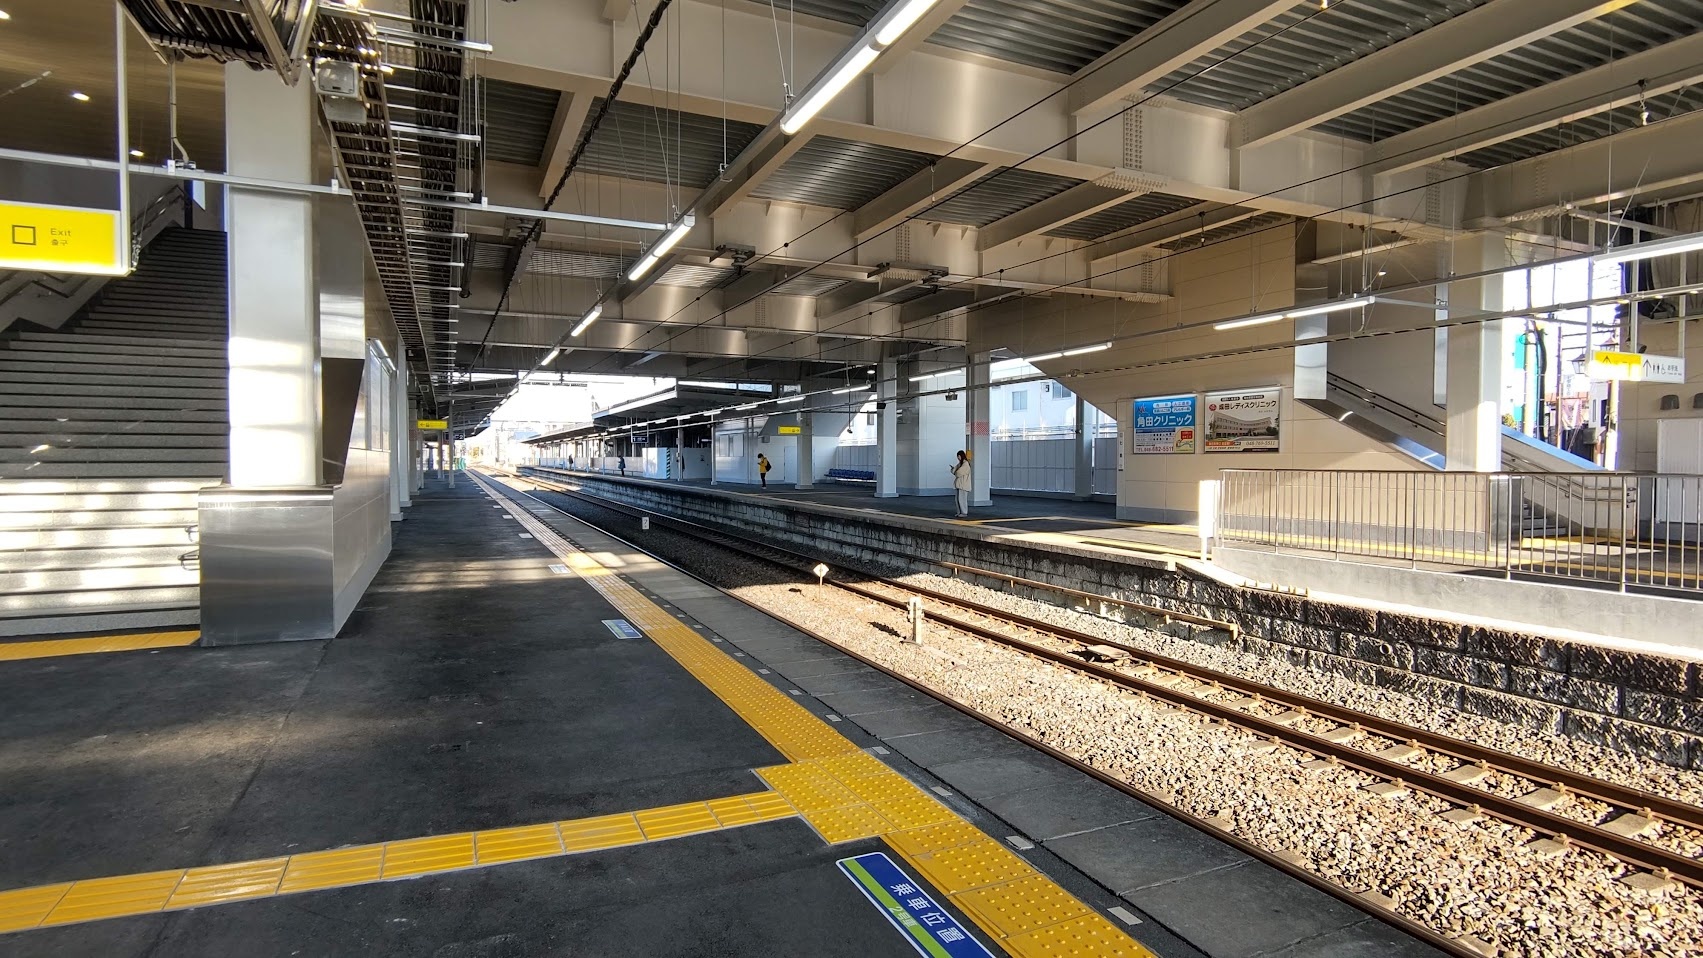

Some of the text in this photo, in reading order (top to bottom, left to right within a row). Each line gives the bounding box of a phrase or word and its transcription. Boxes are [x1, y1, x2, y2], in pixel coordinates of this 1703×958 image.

[50, 227, 71, 237] Exit
[1137, 414, 1192, 427] 角田クリニック
[889, 906, 918, 928] 2号車
[890, 883, 966, 944] 乗車位置
